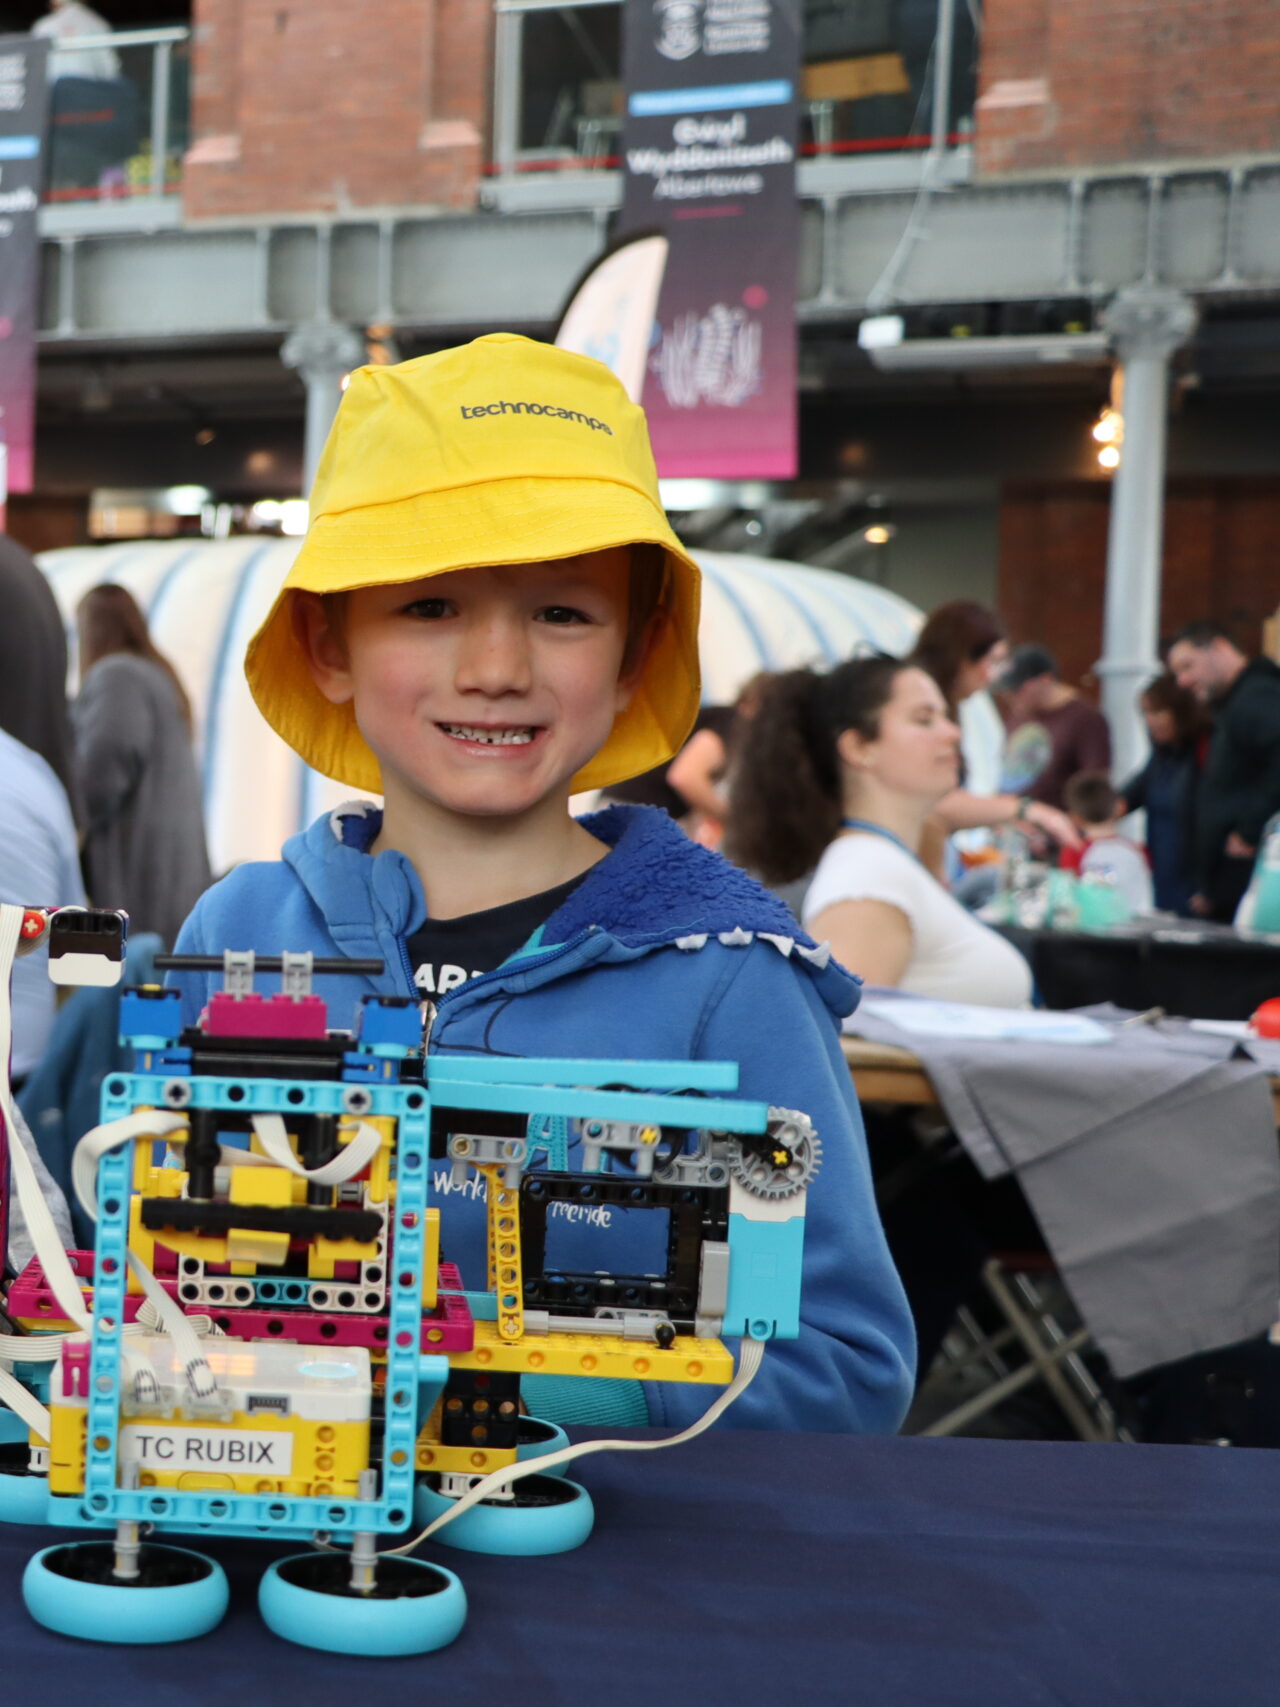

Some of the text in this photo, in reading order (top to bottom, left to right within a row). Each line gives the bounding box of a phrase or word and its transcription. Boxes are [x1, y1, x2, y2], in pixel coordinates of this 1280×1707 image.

[460, 400, 613, 436] technocamps
[136, 1435, 274, 1464] TC RUBIX
